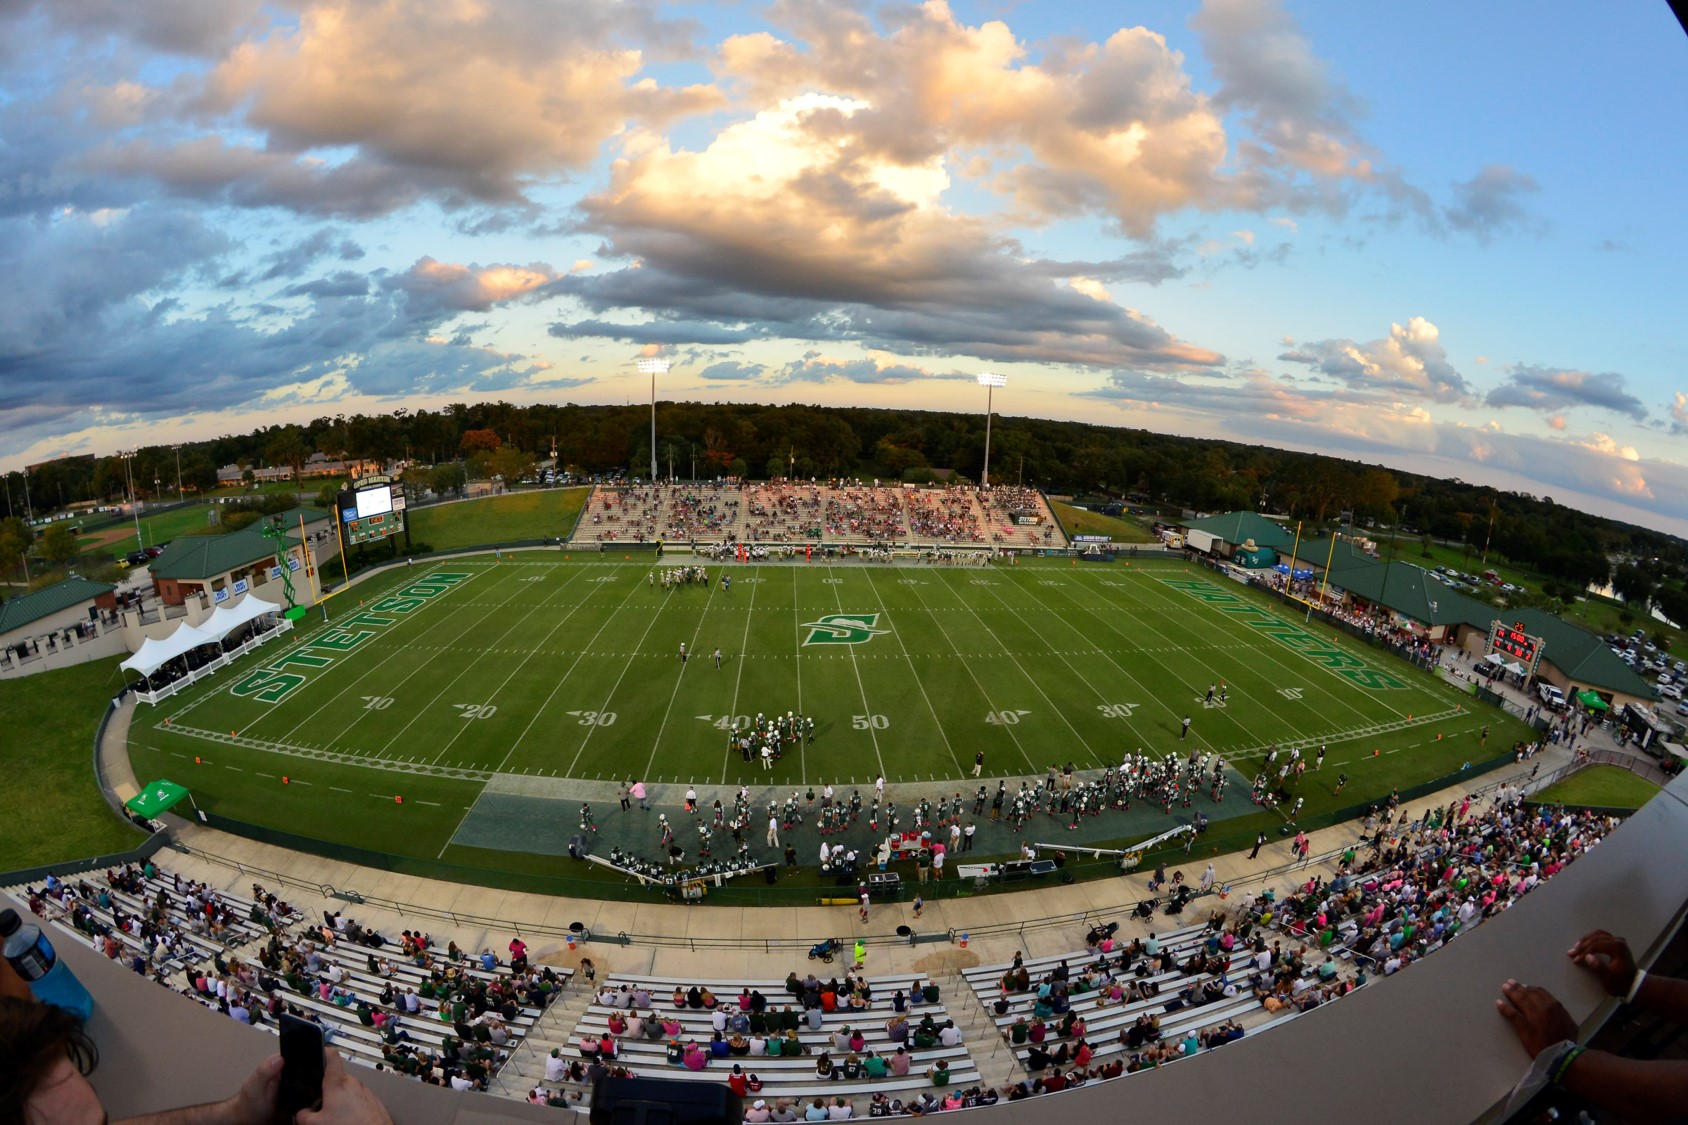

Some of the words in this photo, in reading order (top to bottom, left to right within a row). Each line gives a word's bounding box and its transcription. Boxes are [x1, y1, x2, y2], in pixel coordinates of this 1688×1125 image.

[1158, 578, 1410, 691] HATTERS
[1514, 622, 1524, 632] 25
[230, 571, 475, 704] STETSON
[362, 695, 395, 709] 10
[459, 704, 497, 719] 20
[985, 710, 1020, 725] 40
[1097, 703, 1133, 718] 30
[577, 711, 617, 726] 30
[713, 714, 751, 730] 40
[852, 714, 889, 730] 50
